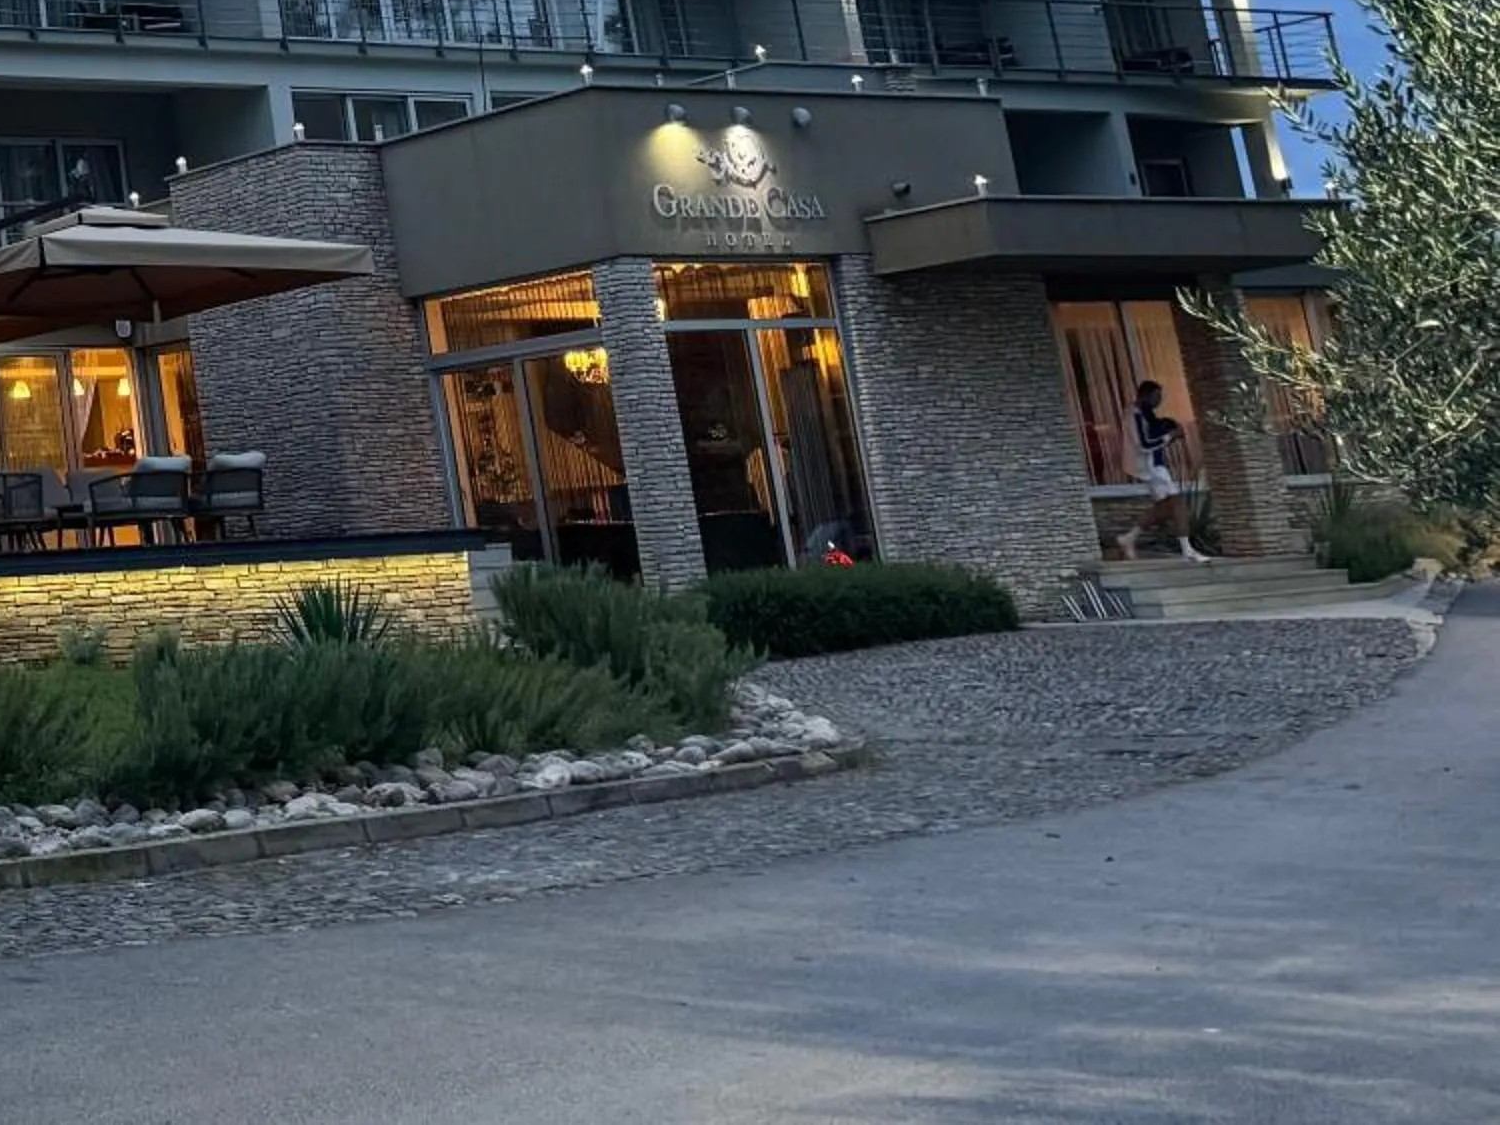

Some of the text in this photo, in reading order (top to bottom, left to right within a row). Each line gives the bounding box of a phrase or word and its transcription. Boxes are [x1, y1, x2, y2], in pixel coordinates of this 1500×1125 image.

[653, 184, 825, 218] GRANDE CASA
[706, 231, 792, 247] HOTEL
